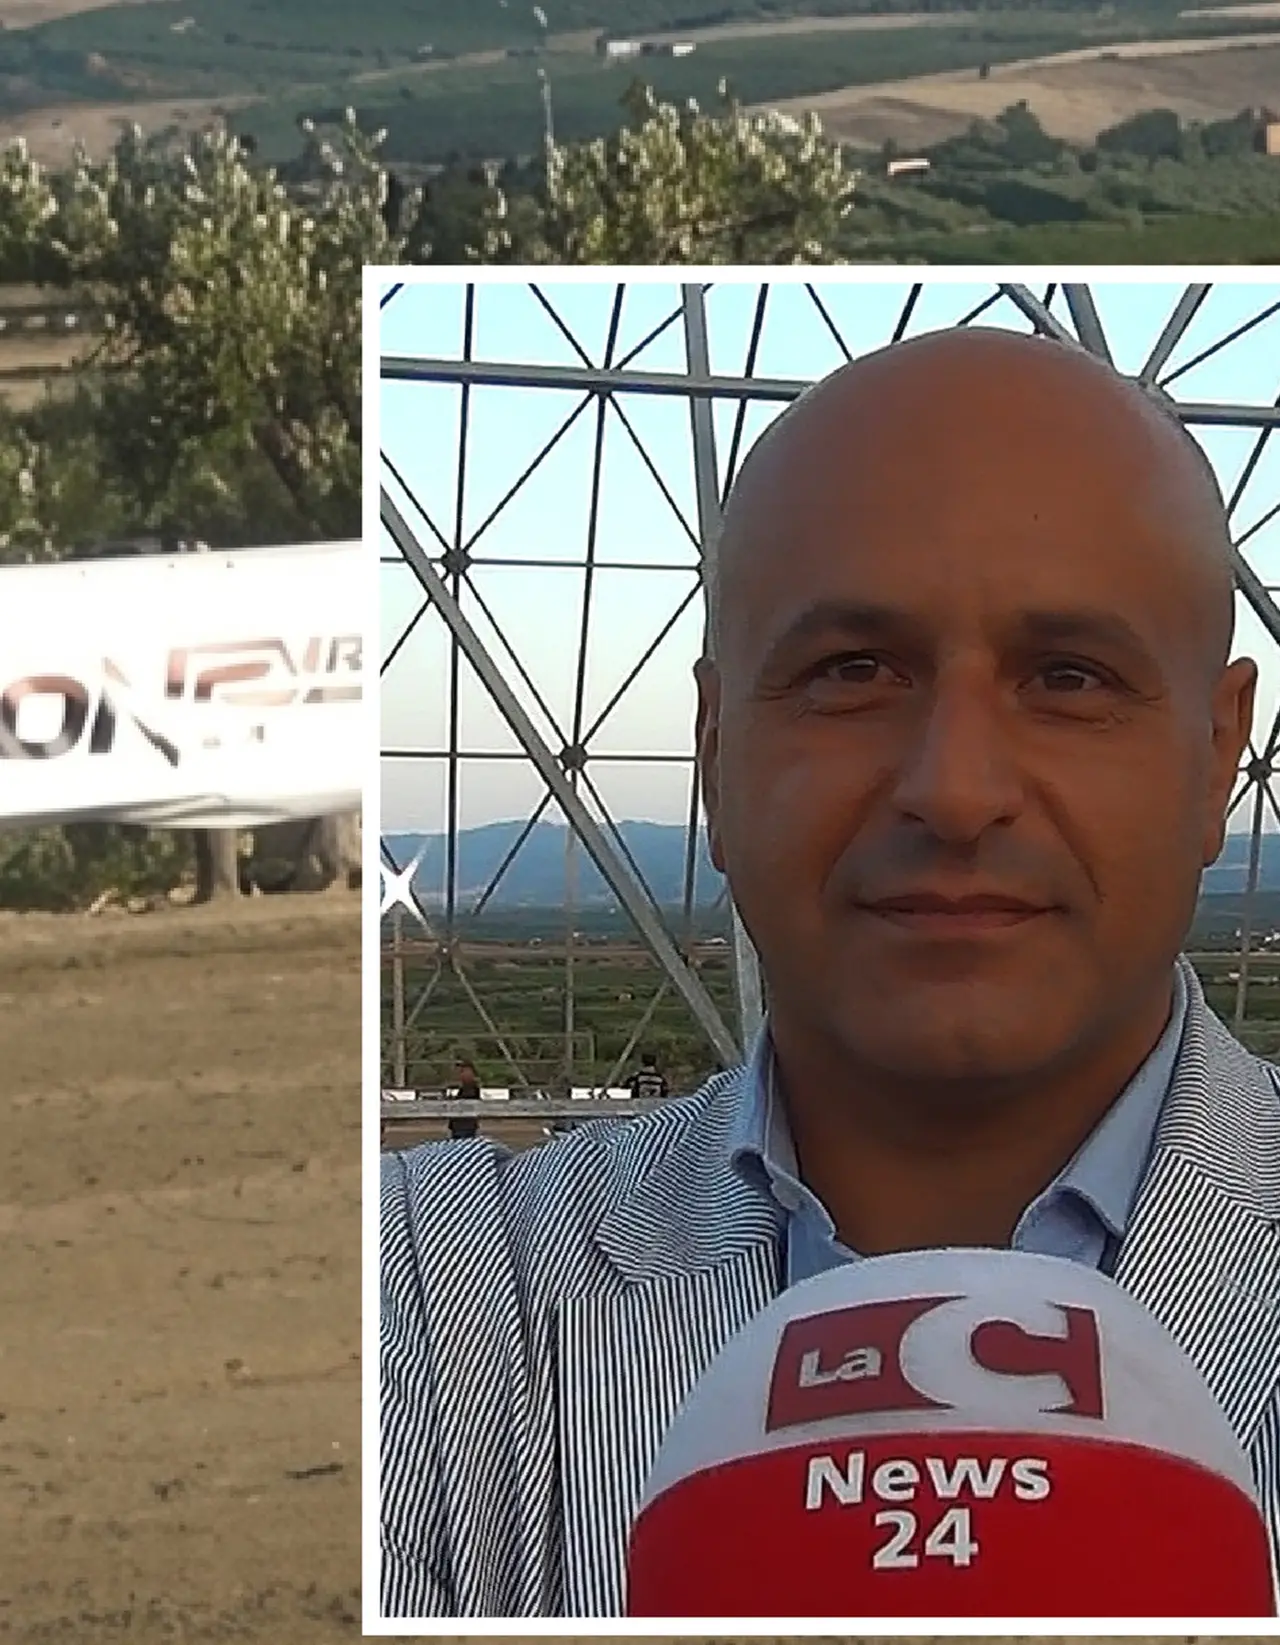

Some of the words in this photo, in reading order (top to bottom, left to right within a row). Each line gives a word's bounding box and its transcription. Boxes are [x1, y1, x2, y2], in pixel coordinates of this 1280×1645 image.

[799, 1342, 883, 1387] La
[900, 1295, 1070, 1412] C
[804, 1449, 1052, 1511] News
[871, 1507, 979, 1569] 24
